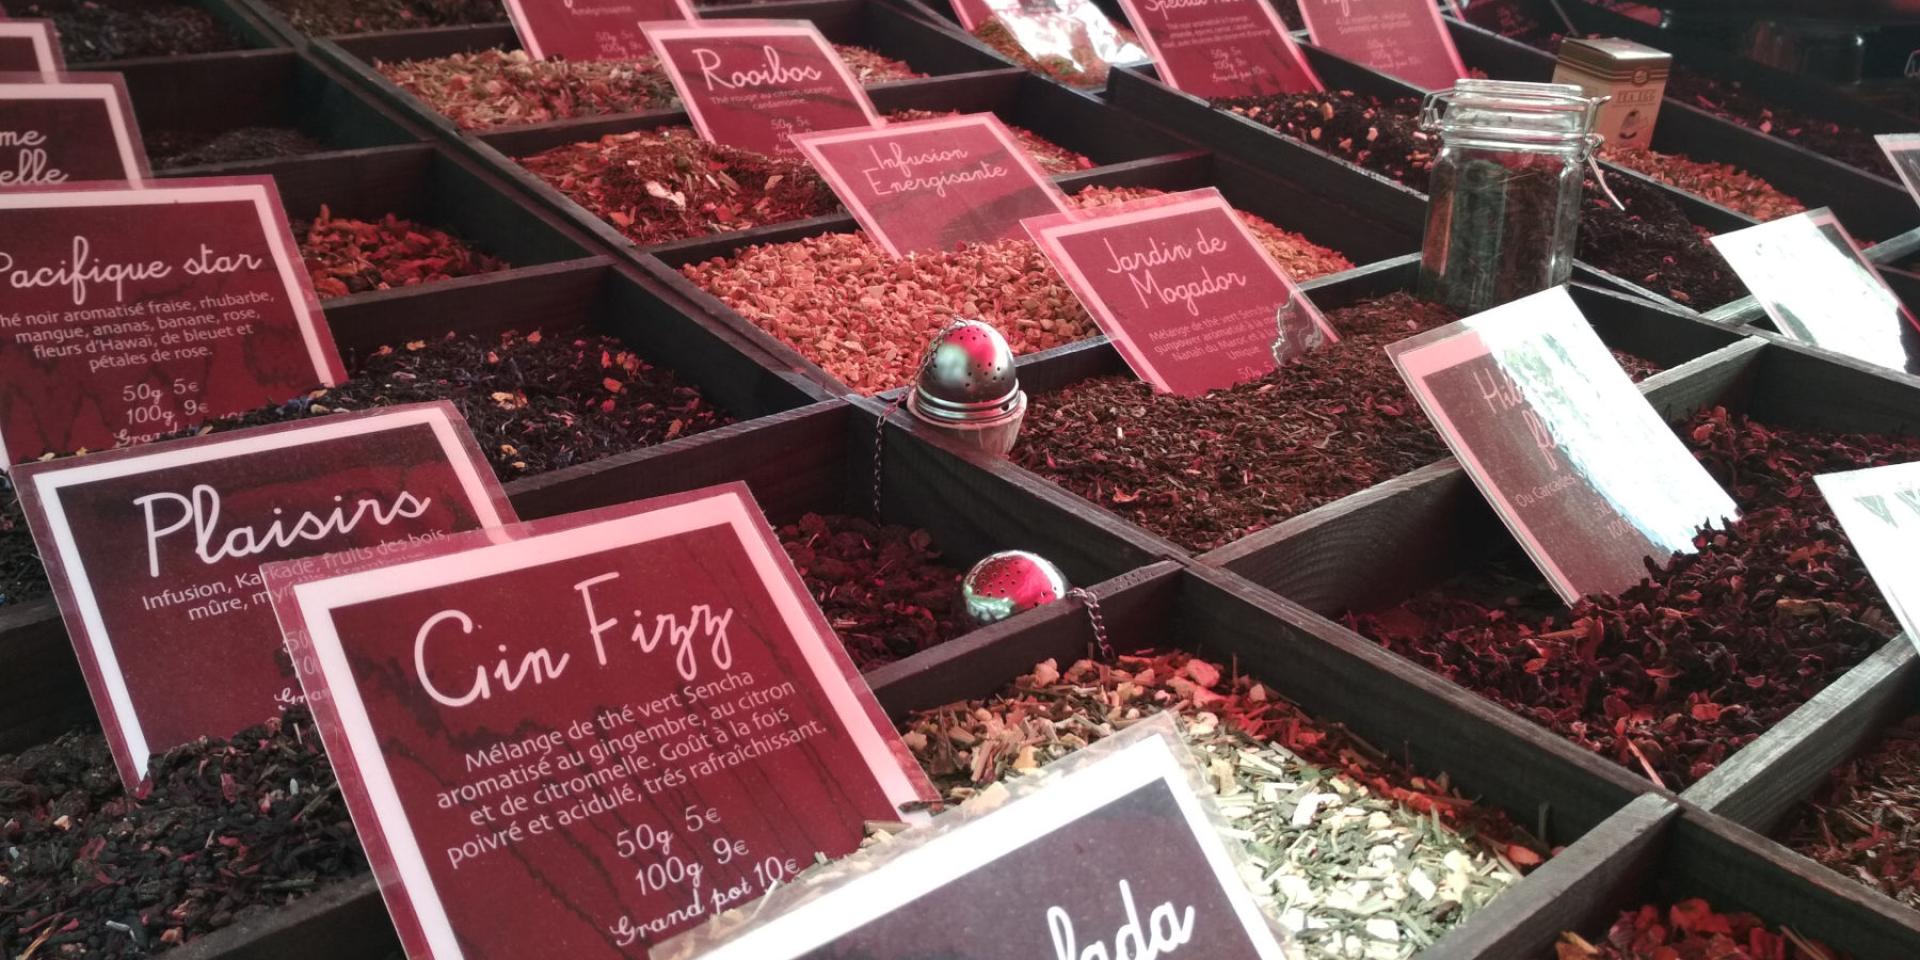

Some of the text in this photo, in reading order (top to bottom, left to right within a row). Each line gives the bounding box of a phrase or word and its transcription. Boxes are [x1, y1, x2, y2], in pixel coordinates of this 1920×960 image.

[692, 45, 822, 91] Rooibos
[0, 130, 47, 147] me
[869, 142, 968, 177] Infusion
[0, 148, 69, 186] elle
[862, 161, 1008, 198] Energisante
[182, 243, 262, 276] star
[1104, 228, 1226, 273] Jardin de
[25, 309, 59, 327] noir
[63, 303, 144, 324] aromatisé
[147, 299, 197, 316] fraise,
[199, 290, 274, 310] rhubarbe,
[1128, 266, 1246, 316] Mogador
[15, 308, 261, 348] mangue, ananas, banane, rose,
[32, 342, 82, 361] fleurs
[161, 331, 180, 346] de
[183, 325, 234, 342] bleuet
[236, 322, 254, 337] et
[89, 344, 213, 374] pétales de rose.
[122, 378, 199, 404] 50g 5€
[126, 399, 209, 427] 100g 9€
[133, 484, 432, 577] Plaisirs
[142, 580, 232, 610] Infusion,
[322, 547, 374, 569] fruits
[378, 536, 408, 556] des
[408, 528, 450, 546] bois,
[189, 596, 248, 620] mûre,
[414, 571, 734, 707] Gin Fizz
[465, 671, 754, 772] Mélange de thé vert Sencha
[436, 681, 796, 809] aromatisé au gingembre, au citron
[469, 706, 789, 826] et de citronnelle. Goût à la fois
[447, 719, 827, 870] poivré et acidulé, trés rafraîchissant.
[616, 804, 721, 858] 50g 5€
[635, 837, 749, 896] 100g 9€
[609, 856, 800, 946] Grand pot 10€
